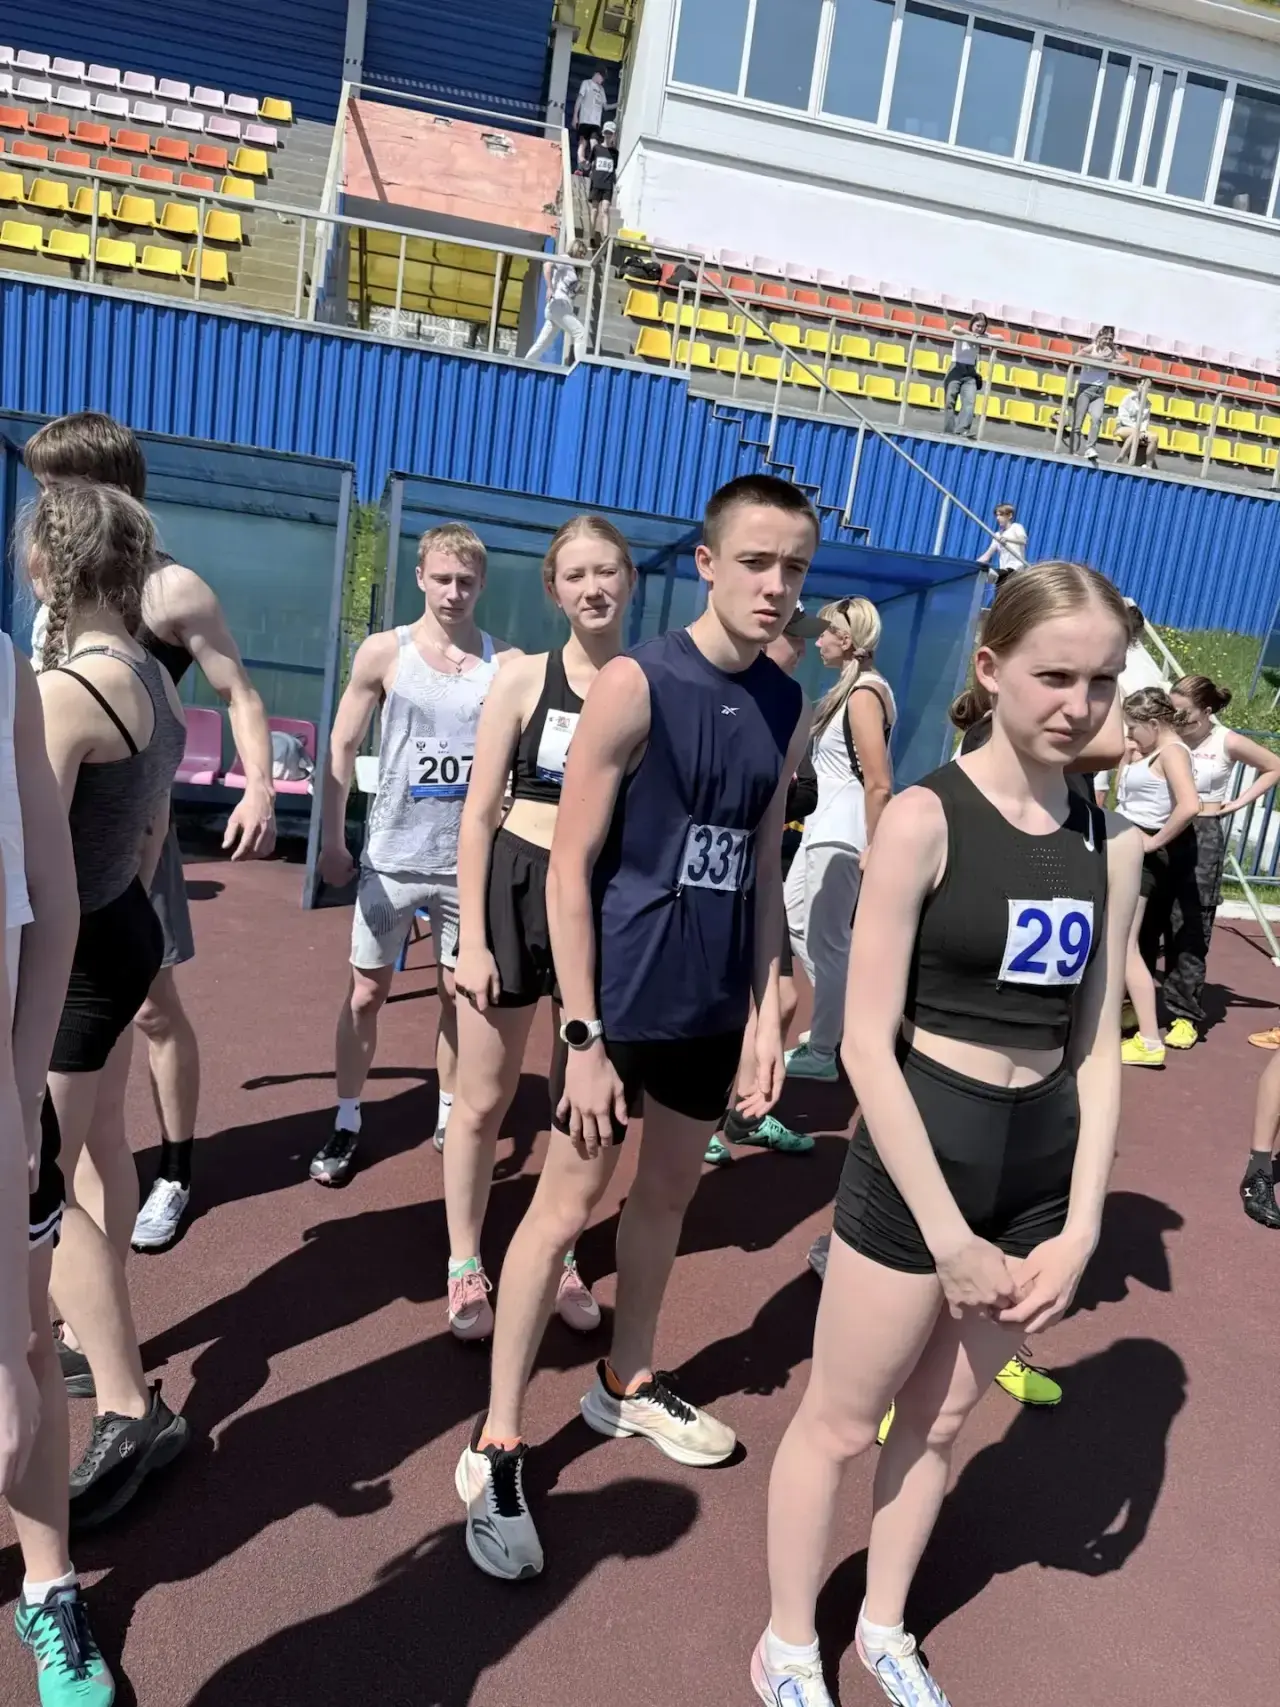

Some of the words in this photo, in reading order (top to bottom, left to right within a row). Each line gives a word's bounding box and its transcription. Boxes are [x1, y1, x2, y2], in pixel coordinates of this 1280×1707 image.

[418, 755, 474, 784] 207
[687, 827, 747, 887] 331
[1007, 908, 1091, 977] 29
